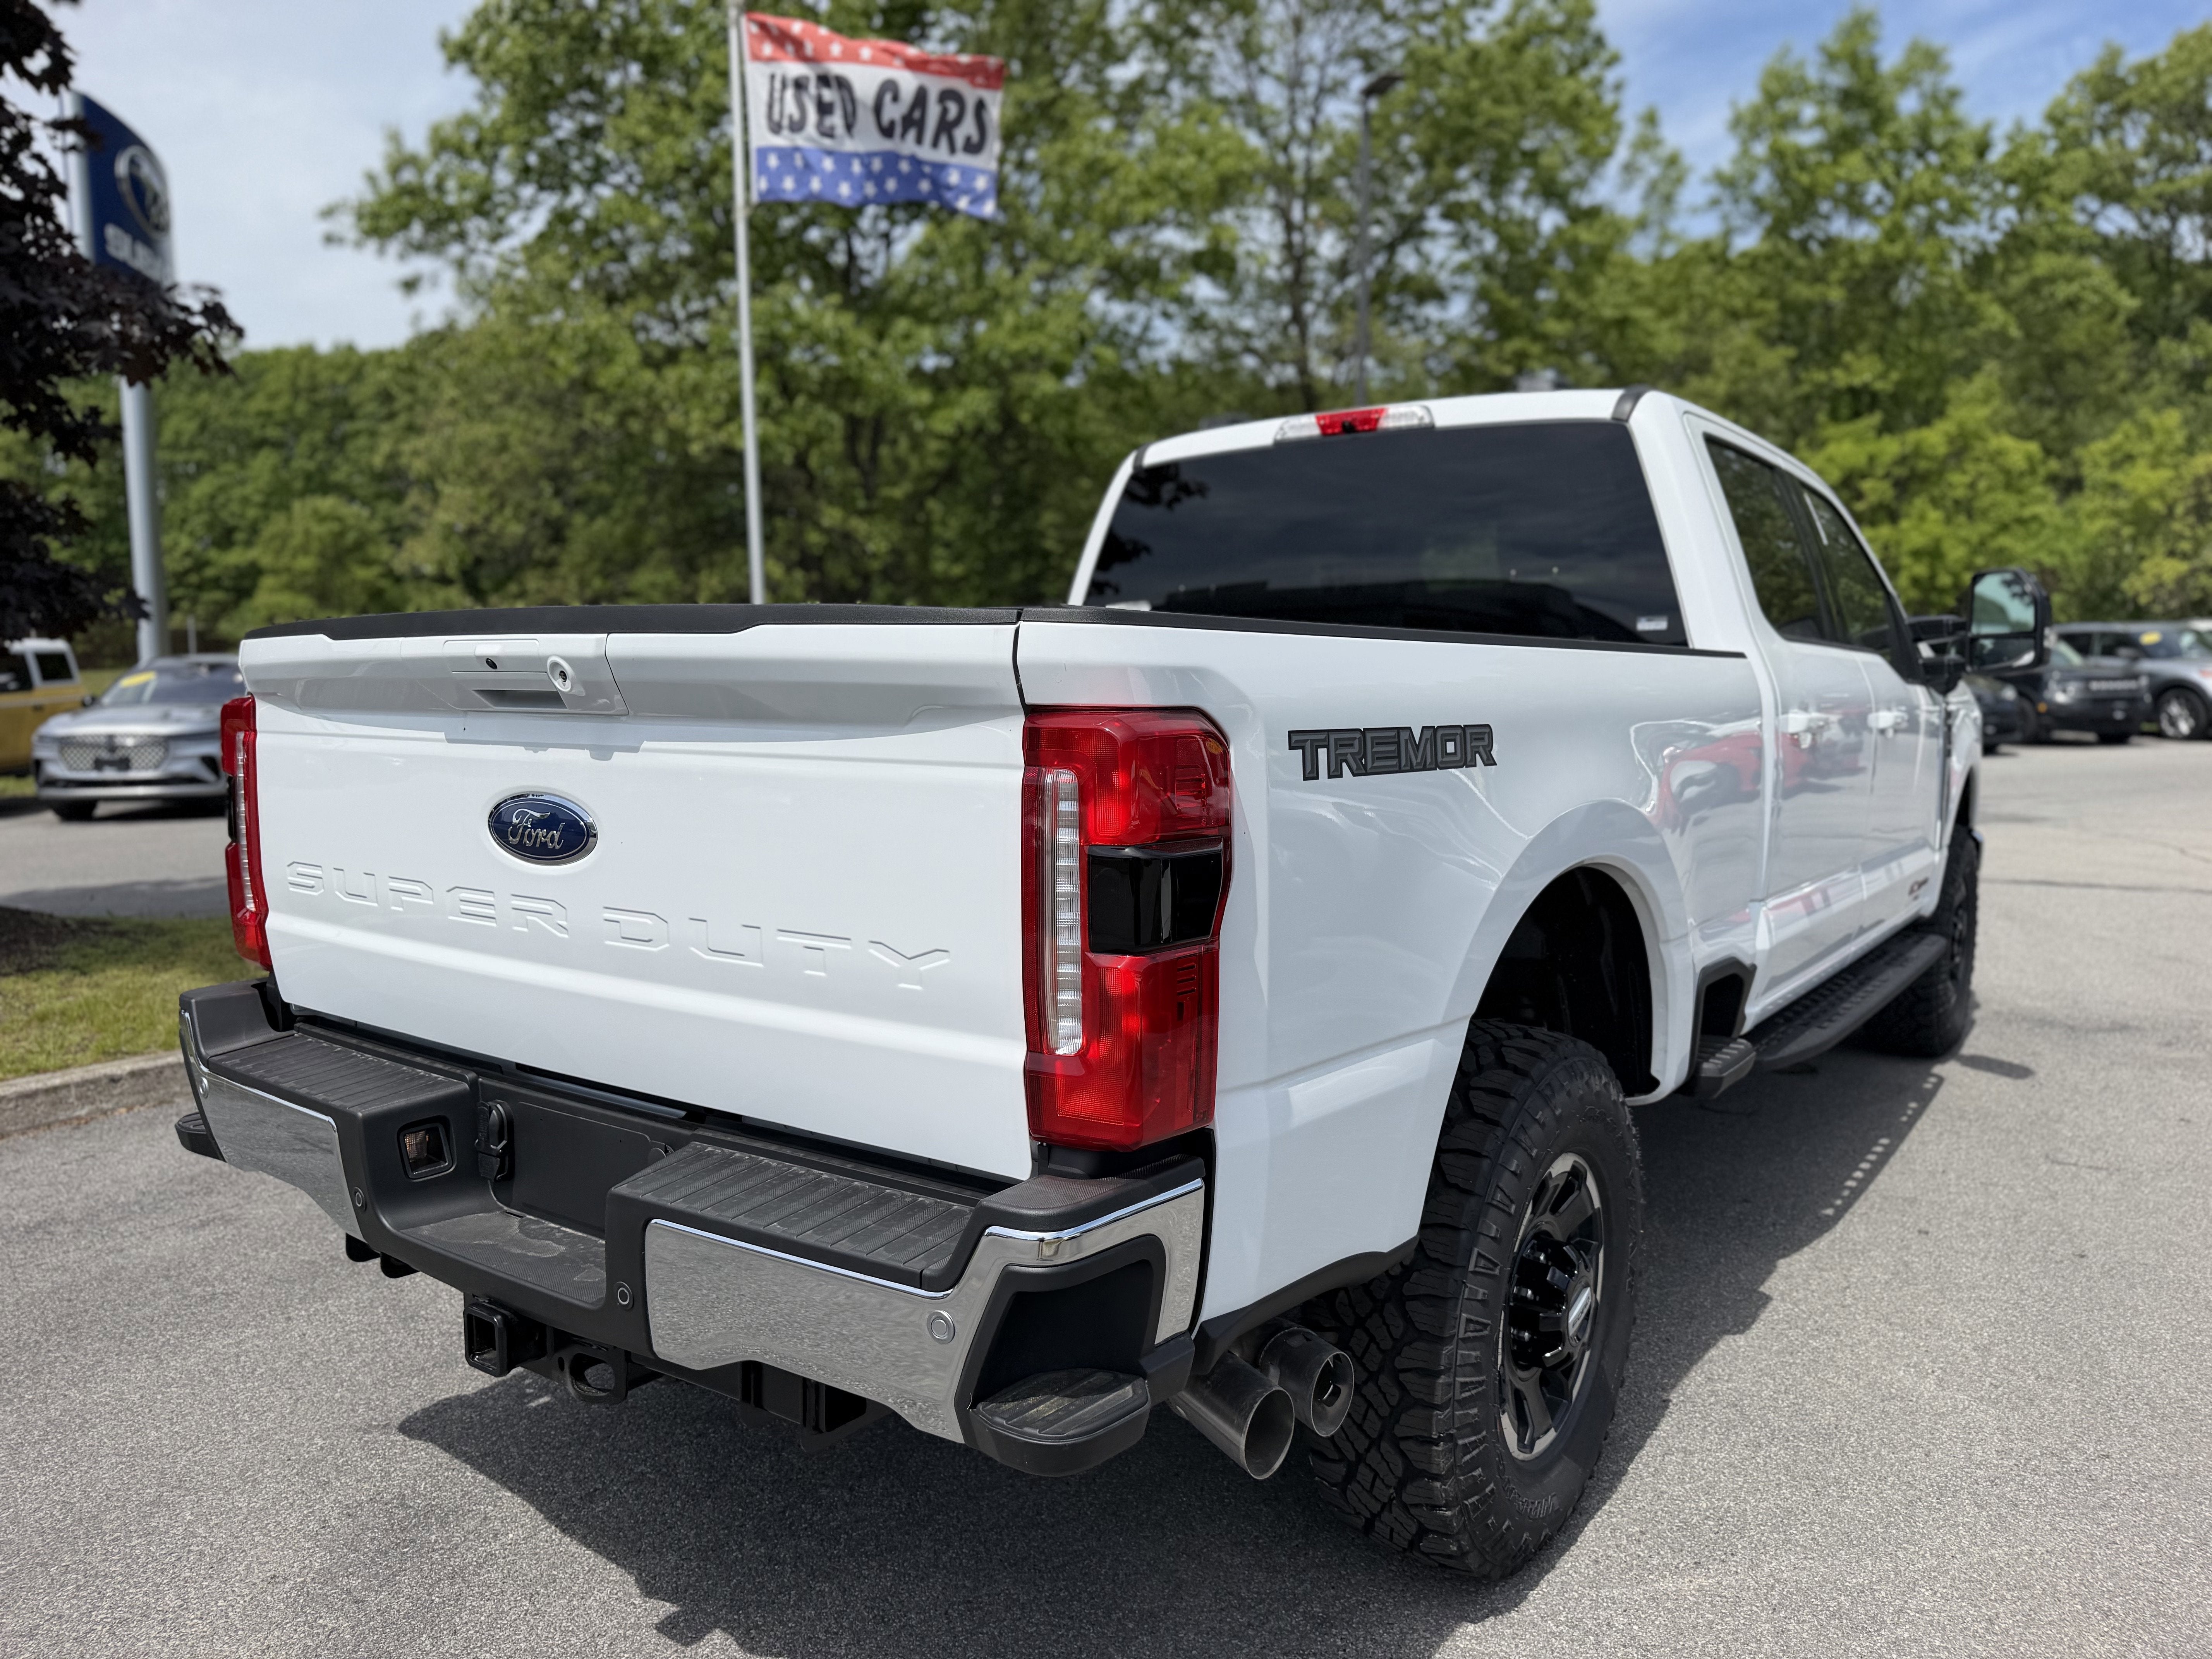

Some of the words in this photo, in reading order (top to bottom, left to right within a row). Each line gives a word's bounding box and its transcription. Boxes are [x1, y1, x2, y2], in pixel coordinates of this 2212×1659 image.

[767, 72, 857, 139] USED
[874, 79, 987, 155] CARS
[1288, 723, 1498, 781] TREMOR
[508, 808, 565, 849] Ford
[287, 860, 569, 938] SUPER
[603, 906, 950, 990] DUTY
